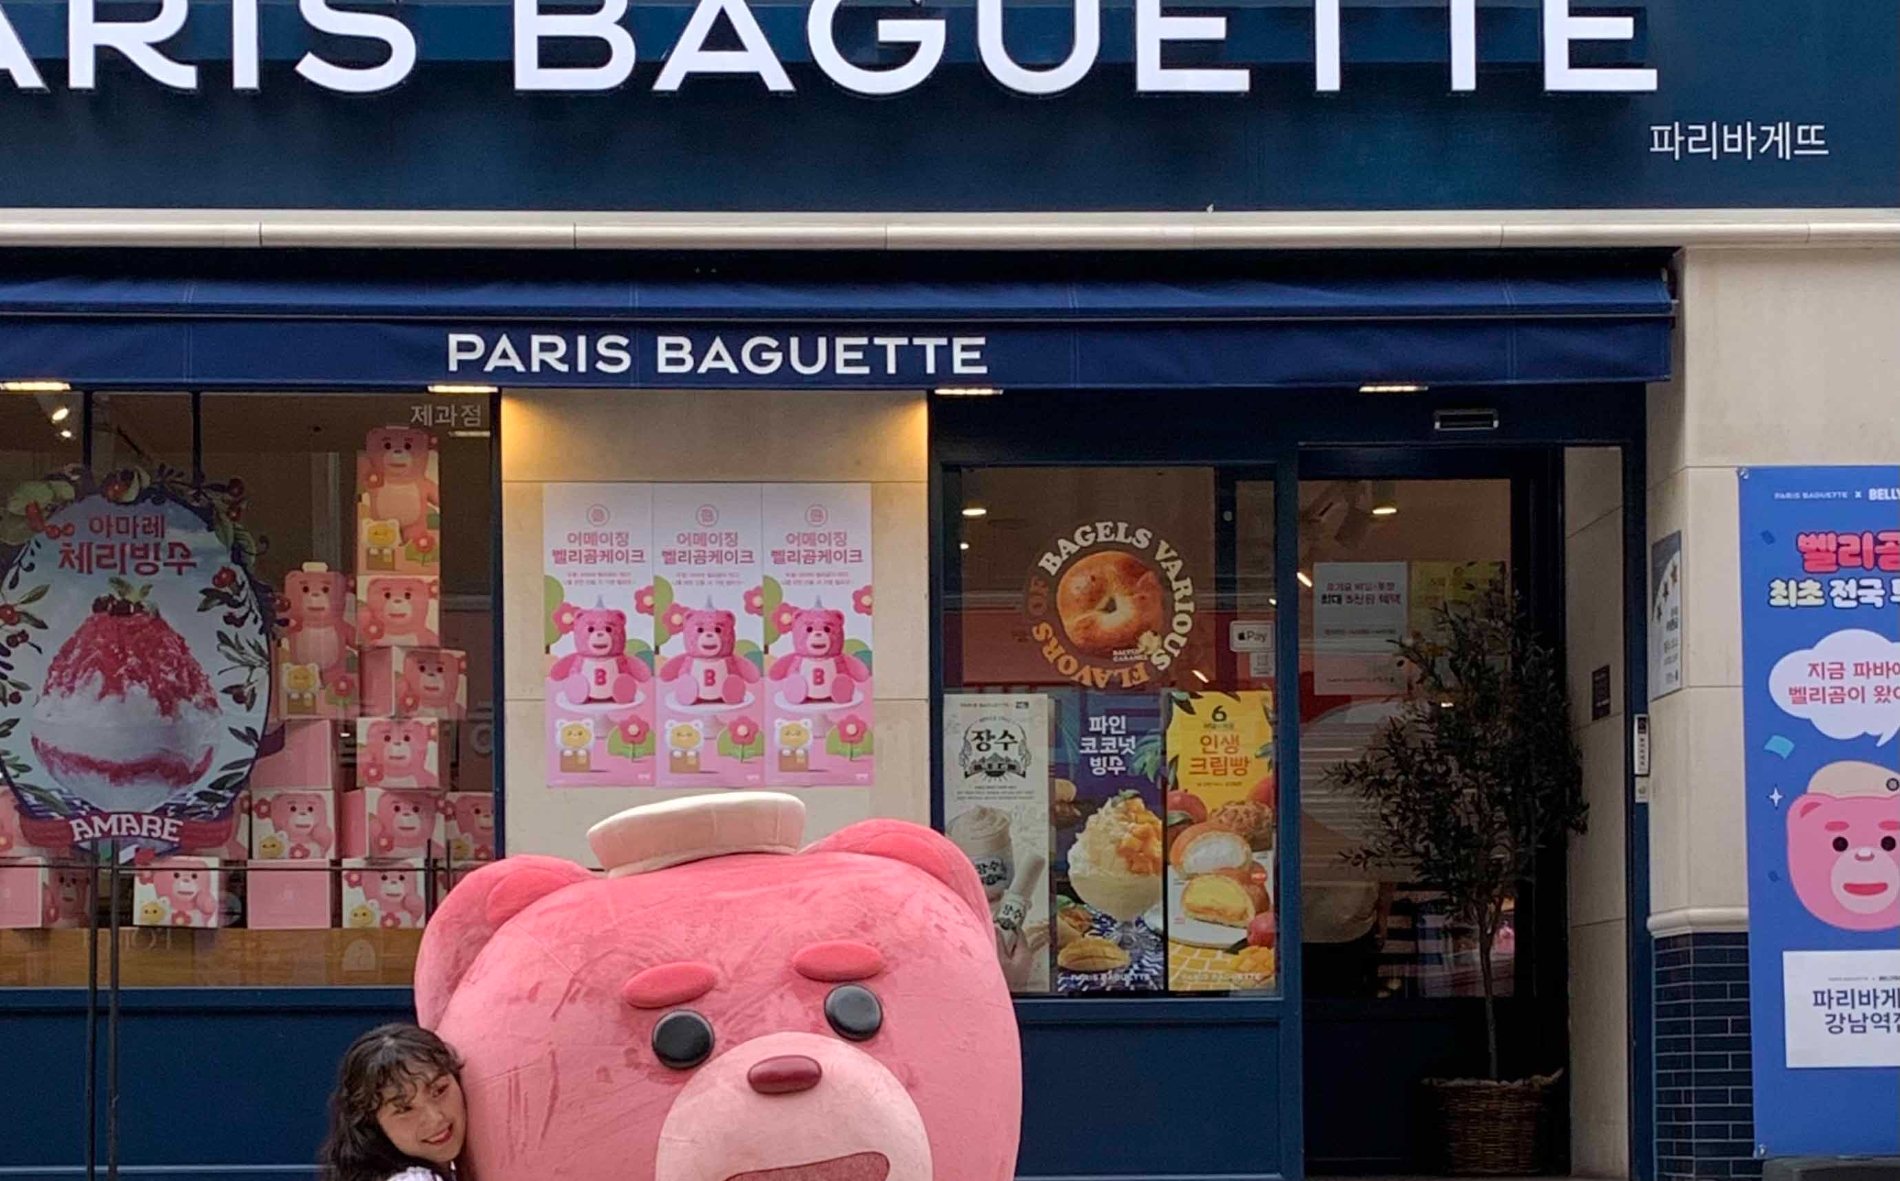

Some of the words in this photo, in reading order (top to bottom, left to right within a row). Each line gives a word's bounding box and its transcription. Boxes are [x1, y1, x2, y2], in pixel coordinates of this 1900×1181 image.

[1650, 121, 1829, 160] 파리바게뜨
[447, 333, 632, 374] PARIS
[657, 336, 988, 375] BAGUETTE
[411, 404, 482, 427] 제과점
[88, 514, 167, 539] 아마레
[567, 531, 629, 548] 어메이징
[676, 531, 739, 548] 어메이징
[785, 531, 848, 548] 어메이징
[1038, 521, 1153, 576] BAGELS
[58, 541, 198, 577] 체리빙수
[552, 549, 646, 565] 벨리곰케이크
[661, 549, 755, 565] 벨리곰케이크
[770, 549, 864, 565] 벨리곰케이크
[1769, 578, 1826, 607] 최초
[1829, 577, 1886, 608] 전국
[1151, 539, 1195, 671] VARIOUS
[1247, 630, 1267, 643] Pay
[1032, 622, 1150, 688] FLAVORS
[594, 668, 607, 687] B
[704, 668, 716, 687] B
[813, 668, 825, 687] B
[1808, 661, 1846, 680] 지금
[1788, 686, 1865, 704] 벨리곰이
[1212, 705, 1227, 722] 6
[1088, 715, 1127, 735] 파인
[971, 728, 1018, 752] 장수
[1079, 736, 1137, 754] 코코넛
[1200, 735, 1241, 754] 인생
[1090, 756, 1127, 776] 빙수
[1189, 756, 1250, 777] 크림빵
